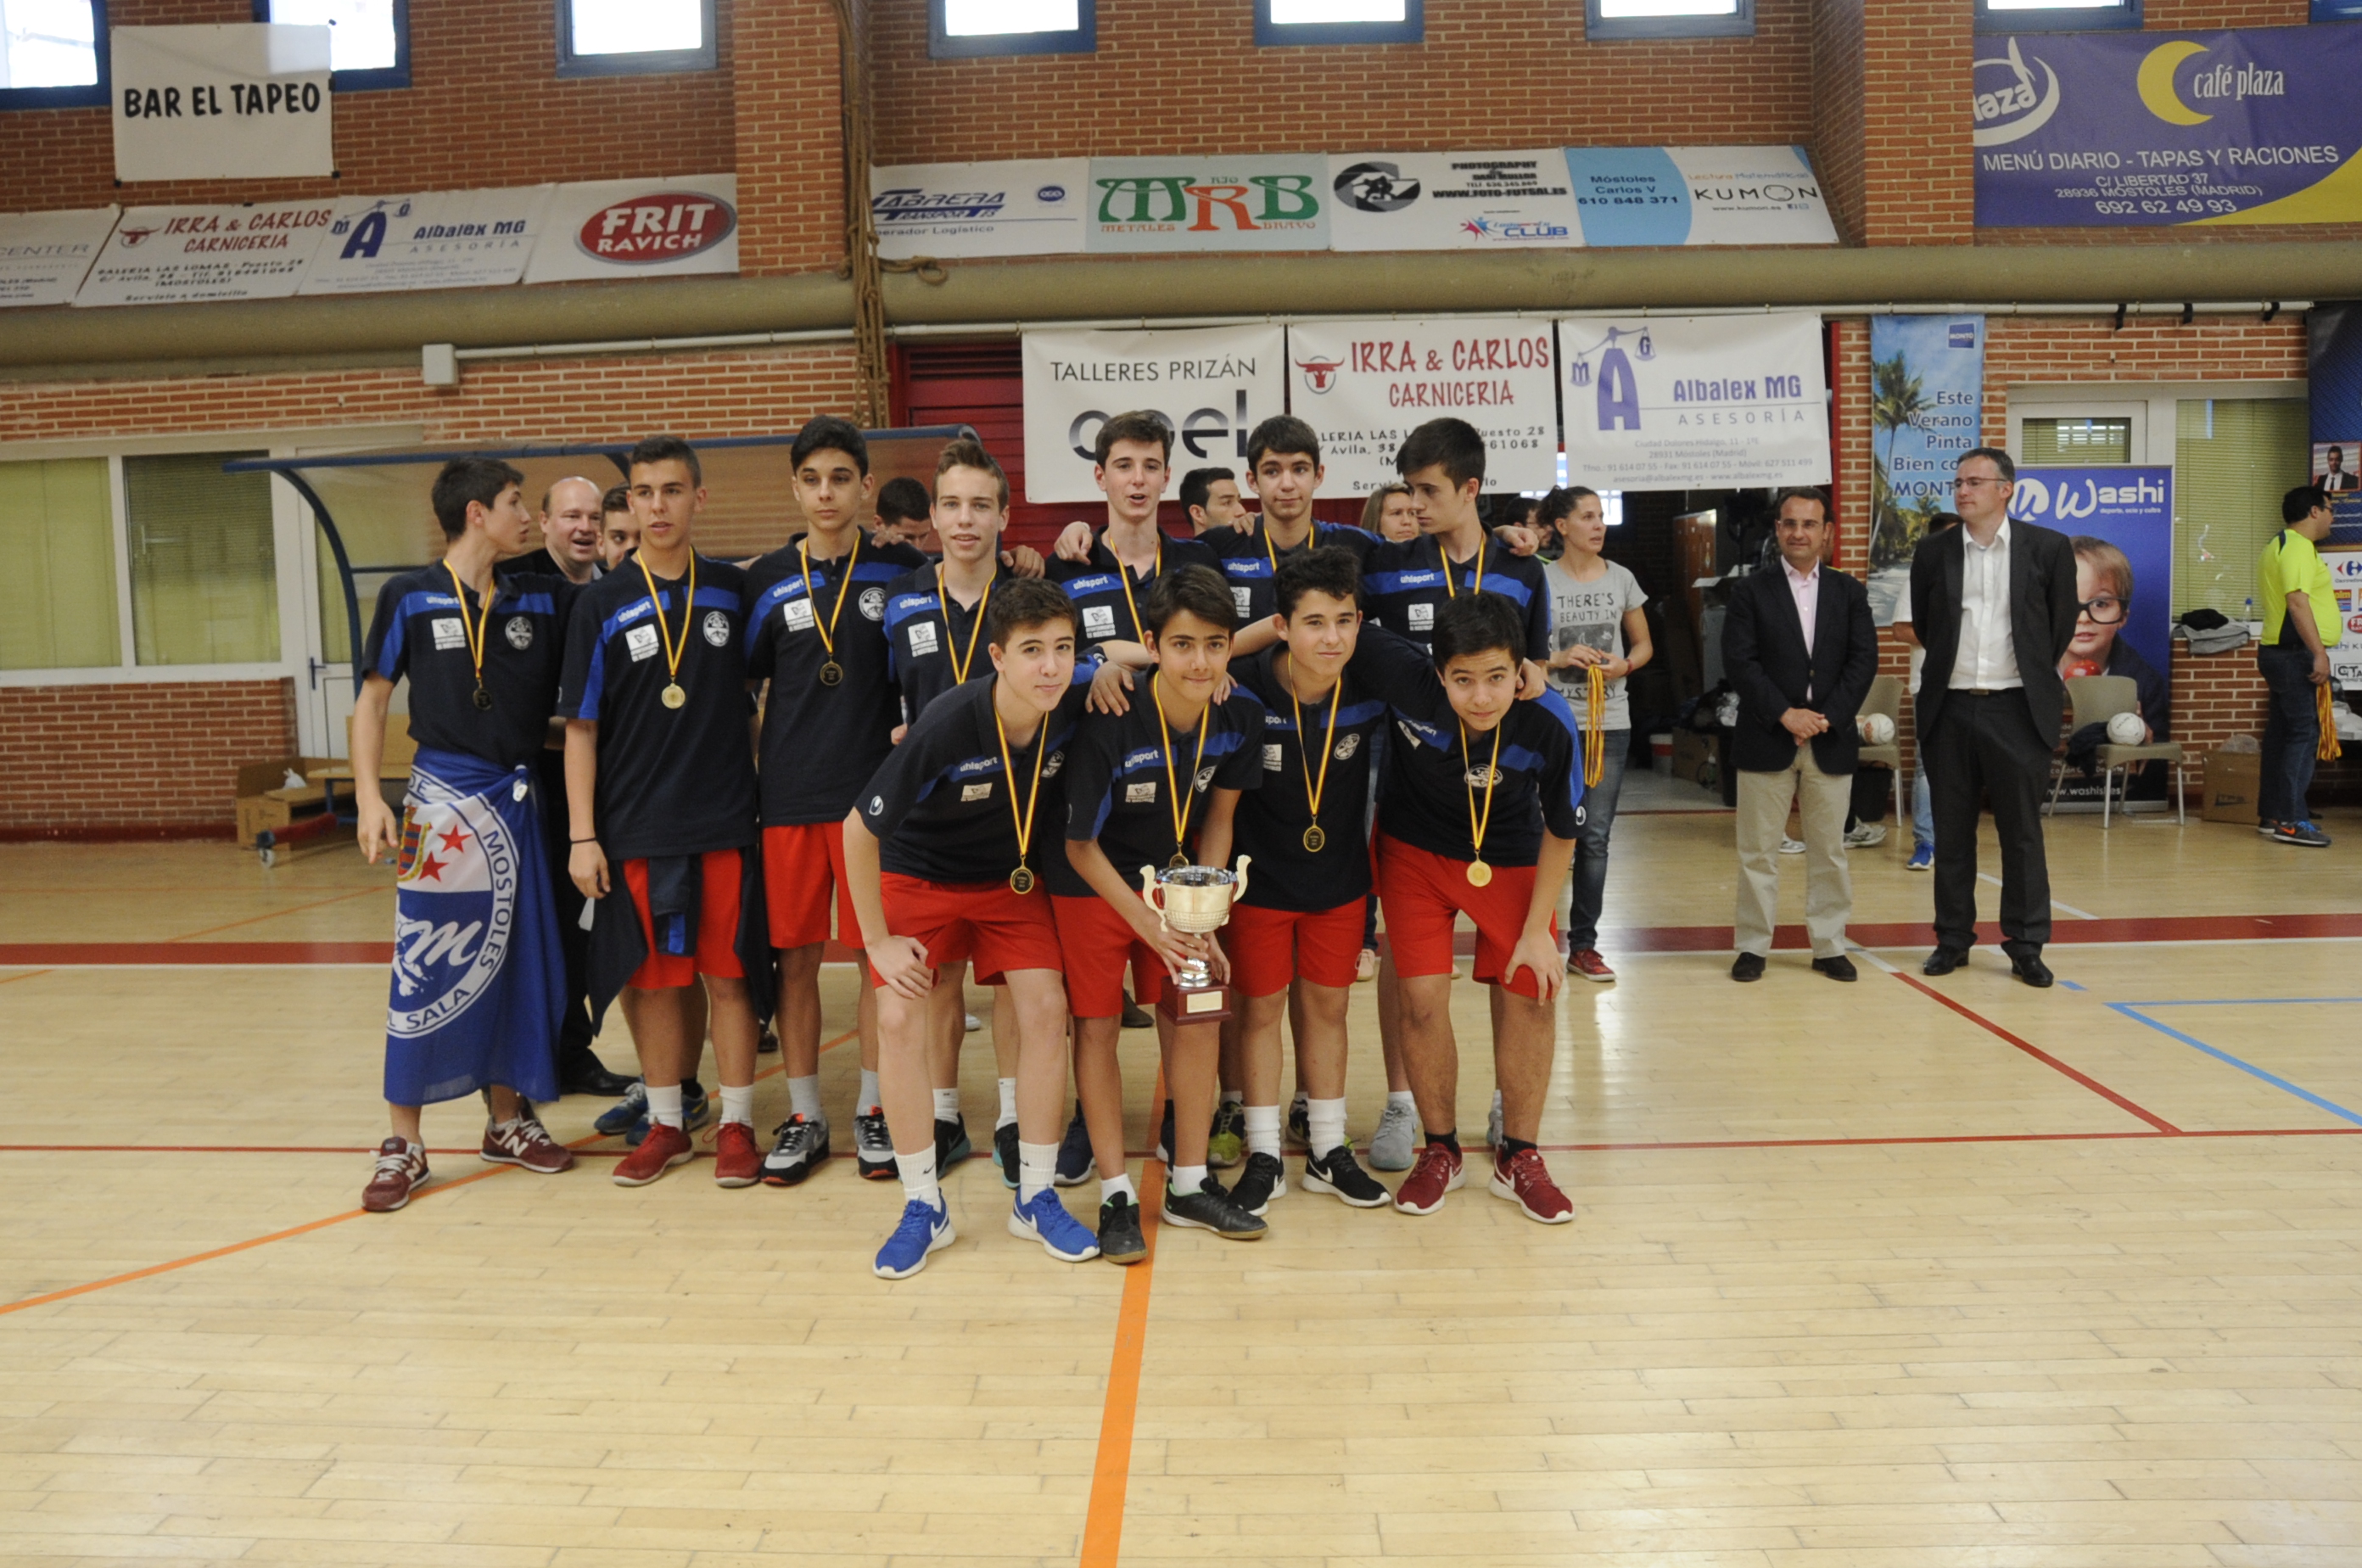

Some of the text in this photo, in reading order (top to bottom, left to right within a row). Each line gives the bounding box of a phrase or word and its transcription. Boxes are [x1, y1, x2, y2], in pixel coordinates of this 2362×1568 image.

[2194, 63, 2285, 100] café plaza
[125, 82, 321, 118] BAR EL TAPEO
[1974, 81, 2036, 121] laza
[1452, 161, 1537, 171] PHOTOGRAPHY
[1983, 150, 2044, 171] MENÚ
[2050, 152, 2120, 170] DIARIO
[2137, 150, 2205, 168] TAPAS
[2207, 149, 2221, 166] Y
[2229, 145, 2340, 165] RACIONES
[1591, 175, 1655, 183] Móstoles
[2096, 172, 2208, 188] C/ LIBERTAD 37
[1595, 185, 1656, 194] Carlos V
[1694, 184, 1818, 202] KUMON
[2102, 184, 2188, 197] MÓSTOLES
[2191, 184, 2264, 197] (MADRID)
[2096, 198, 2237, 215] 692 62 49 93
[165, 209, 332, 234] IRRA & CARLOS
[601, 204, 716, 237] FRIT
[1101, 224, 1175, 233] METALES
[1263, 221, 1316, 230] BRAVO
[340, 211, 387, 259] A
[413, 220, 526, 239] Albalex MG
[875, 227, 928, 236] perador
[1504, 226, 1568, 237] CLUB
[184, 234, 288, 253] CARNICERIA
[597, 233, 702, 253] RAVICH
[1639, 336, 1650, 356] G
[1352, 337, 1550, 372] IRRA & CARLOS
[1050, 355, 1256, 381] TALLERES PRIZÁN
[1572, 362, 1589, 382] M
[1389, 380, 1514, 407] CARNICERIA
[1597, 348, 1641, 430] A
[1674, 375, 1801, 401] Albalex MG
[1937, 391, 1973, 405] Este
[1678, 408, 1804, 425] ASESORÍA
[1908, 413, 1973, 427] Verano
[1069, 389, 1247, 461] oel
[1528, 426, 1544, 435] 28
[1318, 430, 1396, 441] LERIA LAS
[1926, 435, 1973, 449] Pinta
[1378, 443, 1396, 453] 38
[1635, 440, 1662, 448] Ciudad
[1712, 449, 1747, 458] (Madrid)
[1894, 457, 1958, 471] Bien co
[1893, 481, 1955, 496] MONT
[2056, 477, 2164, 520] Washi
[1227, 562, 1260, 574] uhlsport
[1073, 575, 1109, 590] uhlsport
[1400, 573, 1435, 584] uhlsport
[773, 578, 805, 598] uhlsport
[899, 596, 932, 609] uhlsport
[1557, 593, 1615, 608] THERE'S
[1560, 609, 1617, 623] BEAUTY IN
[1559, 686, 1615, 698] MYSTRY
[1265, 715, 1287, 726] sport
[960, 756, 998, 772] uhlsport
[406, 988, 470, 1030] SALA
[504, 1135, 529, 1157] N
